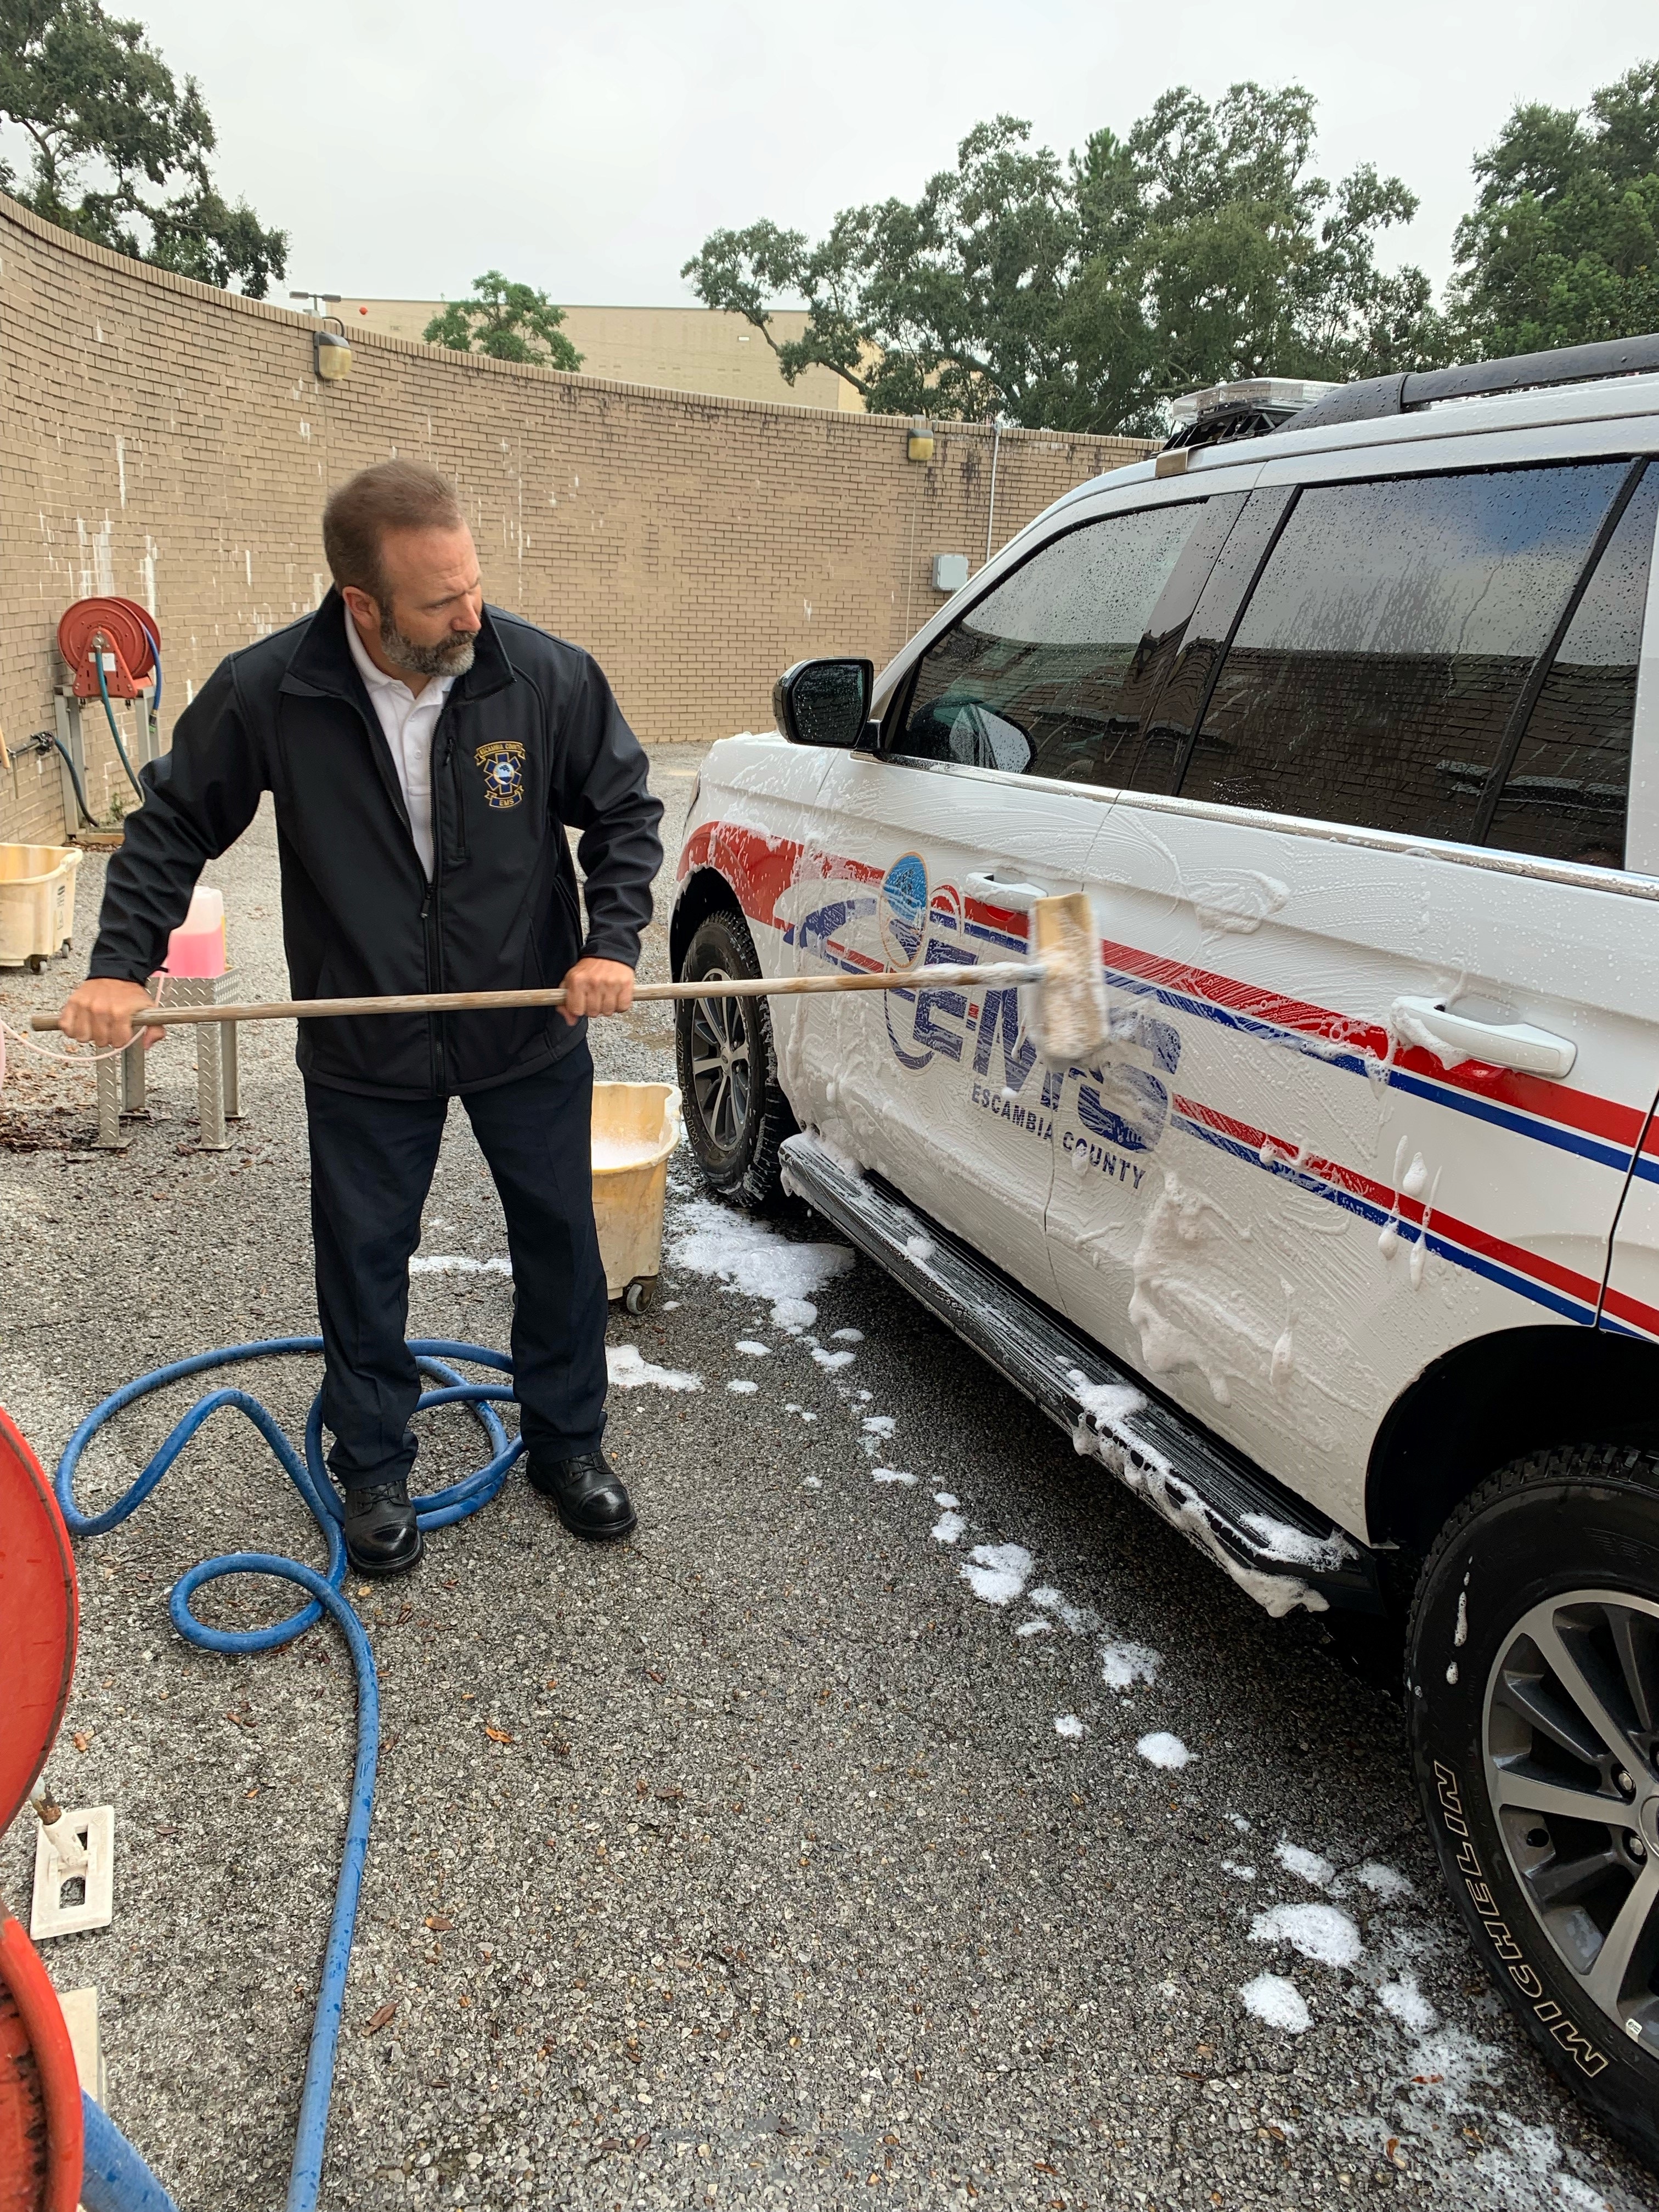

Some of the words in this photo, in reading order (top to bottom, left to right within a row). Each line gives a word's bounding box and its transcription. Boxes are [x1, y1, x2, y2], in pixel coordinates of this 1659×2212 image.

[479, 743, 504, 755] ESCAMBIA
[505, 743, 521, 751] COUN
[676, 1028, 700, 1146] MICHELIN
[912, 938, 1182, 1153] EMS
[972, 1083, 1053, 1140] ESCAMBIA
[1063, 1131, 1146, 1189] COUNTY
[1433, 1759, 1609, 2078] MICHELIN
